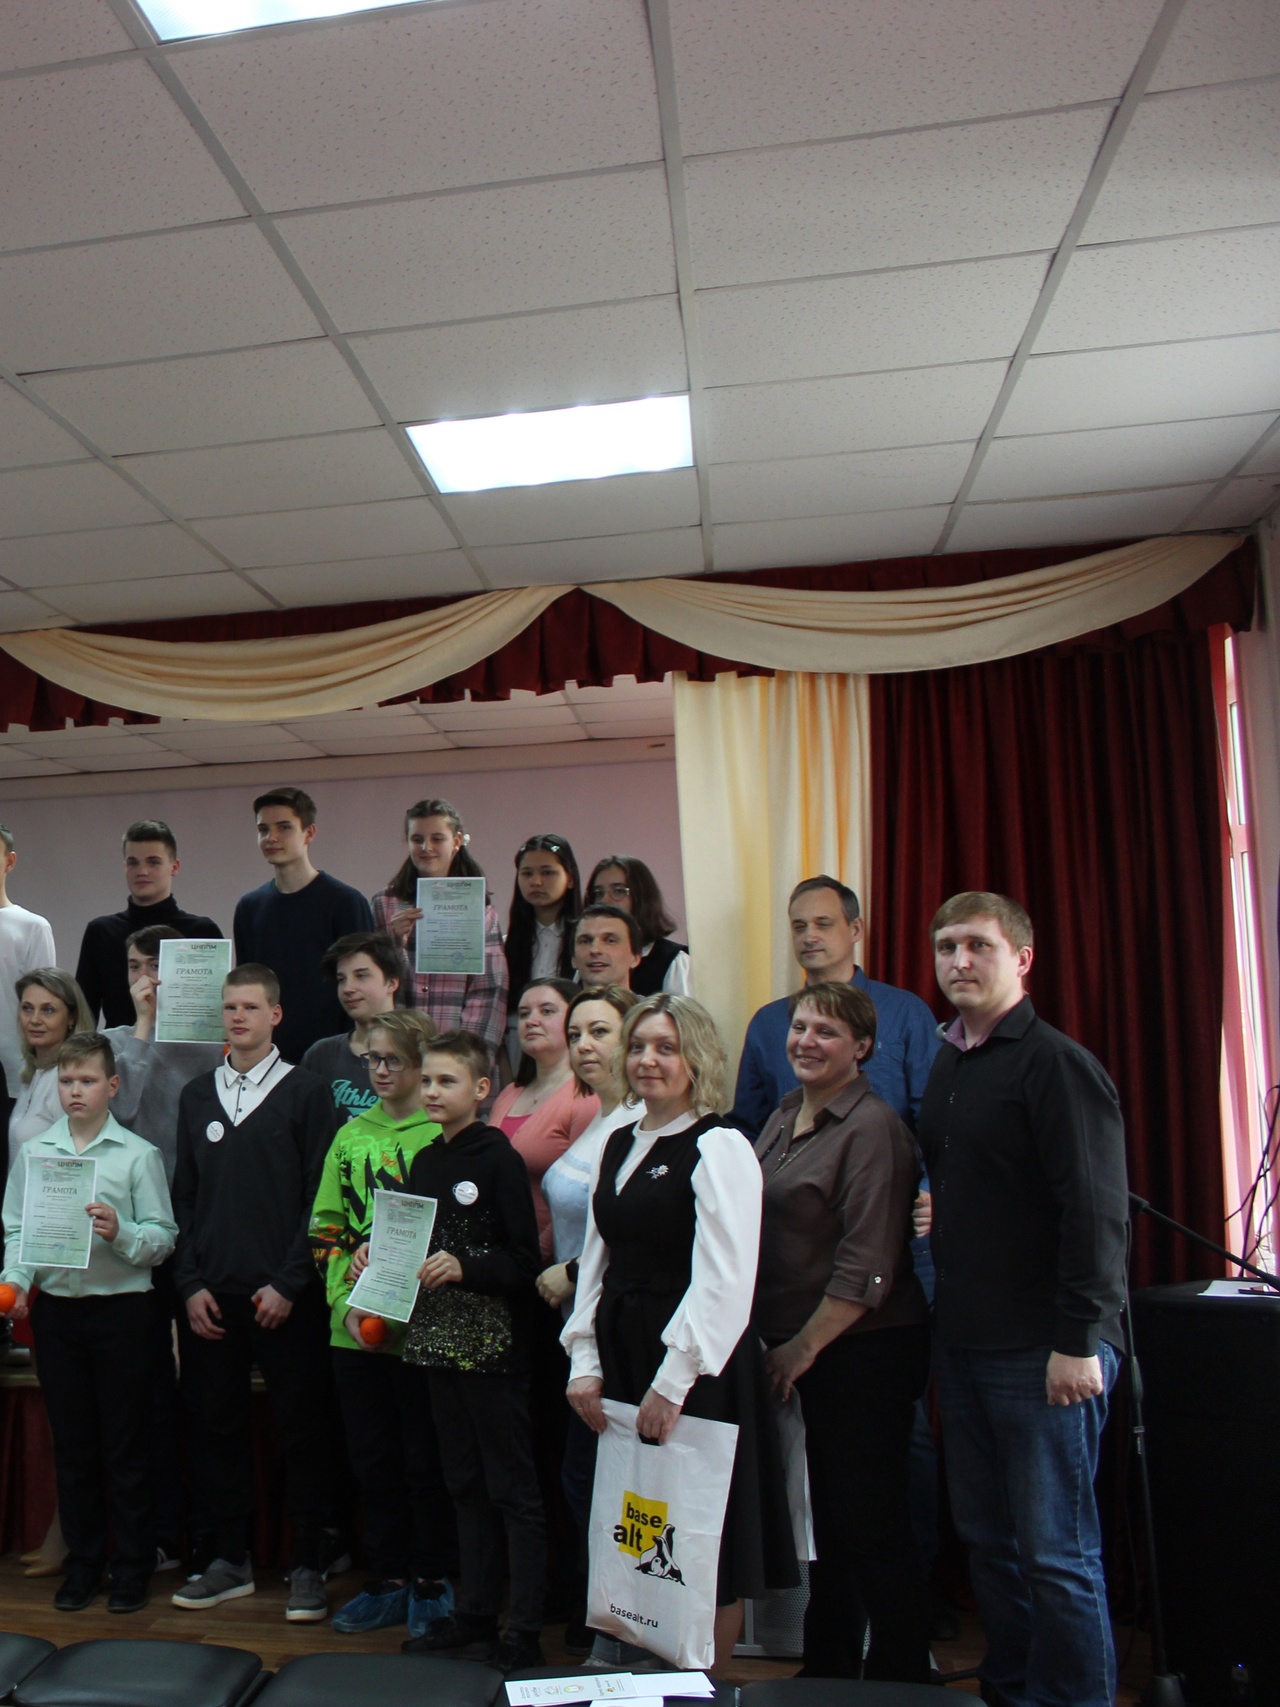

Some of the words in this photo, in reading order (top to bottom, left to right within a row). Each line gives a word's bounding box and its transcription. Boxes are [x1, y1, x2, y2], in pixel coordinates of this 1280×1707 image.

[331, 1079, 382, 1109] Athle
[42, 1186, 78, 1195] ГРАМОТА
[386, 1226, 417, 1239] ГРАМОТА
[626, 1502, 662, 1528] base
[613, 1523, 642, 1552] alt
[610, 1603, 658, 1628] basealt.ru
